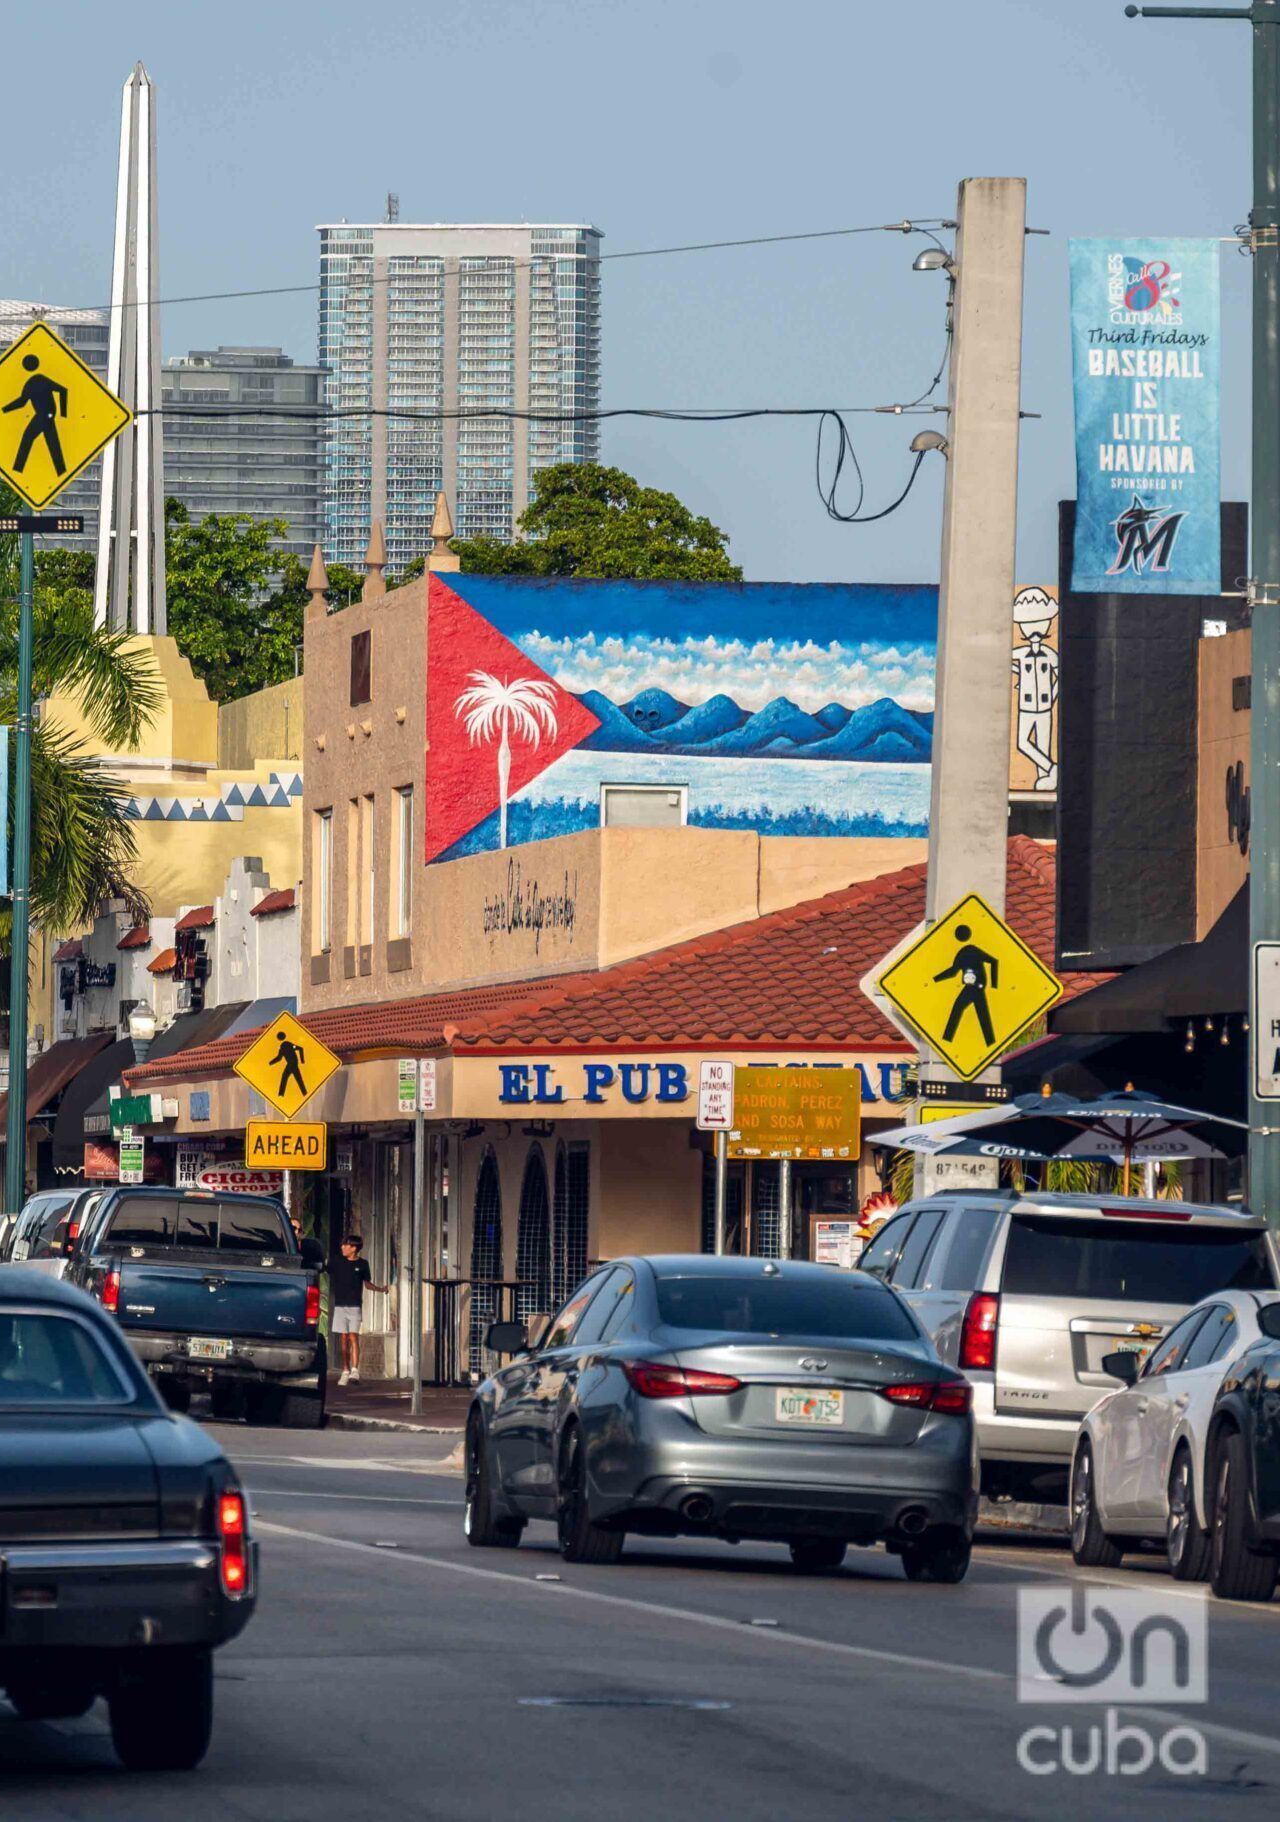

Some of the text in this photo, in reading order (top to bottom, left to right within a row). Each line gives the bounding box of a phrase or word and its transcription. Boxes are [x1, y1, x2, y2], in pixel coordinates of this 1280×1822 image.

[1108, 253, 1124, 312] VIERNES
[1110, 311, 1183, 325] CULTURALES
[1087, 328, 1209, 349] Third Fridays
[1088, 348, 1204, 378] BASEBALL
[1134, 381, 1158, 409] IS
[1113, 413, 1182, 441] LITTLE
[1099, 444, 1196, 474] HAVANA
[1111, 478, 1183, 491] SPONSORED BY
[709, 1066, 723, 1080] NO
[499, 1062, 689, 1104] EL PUB
[701, 1082, 731, 1091] STANDING
[709, 1094, 722, 1103] ANY
[801, 1095, 843, 1110] PEREZ
[771, 1115, 804, 1128] SOSA
[816, 1116, 843, 1129] WAY
[253, 1135, 319, 1157] AHEAD
[180, 1153, 199, 1162] BUY
[180, 1163, 196, 1172] GET
[180, 1172, 196, 1181] FRE
[202, 1172, 283, 1184] CIGAR
